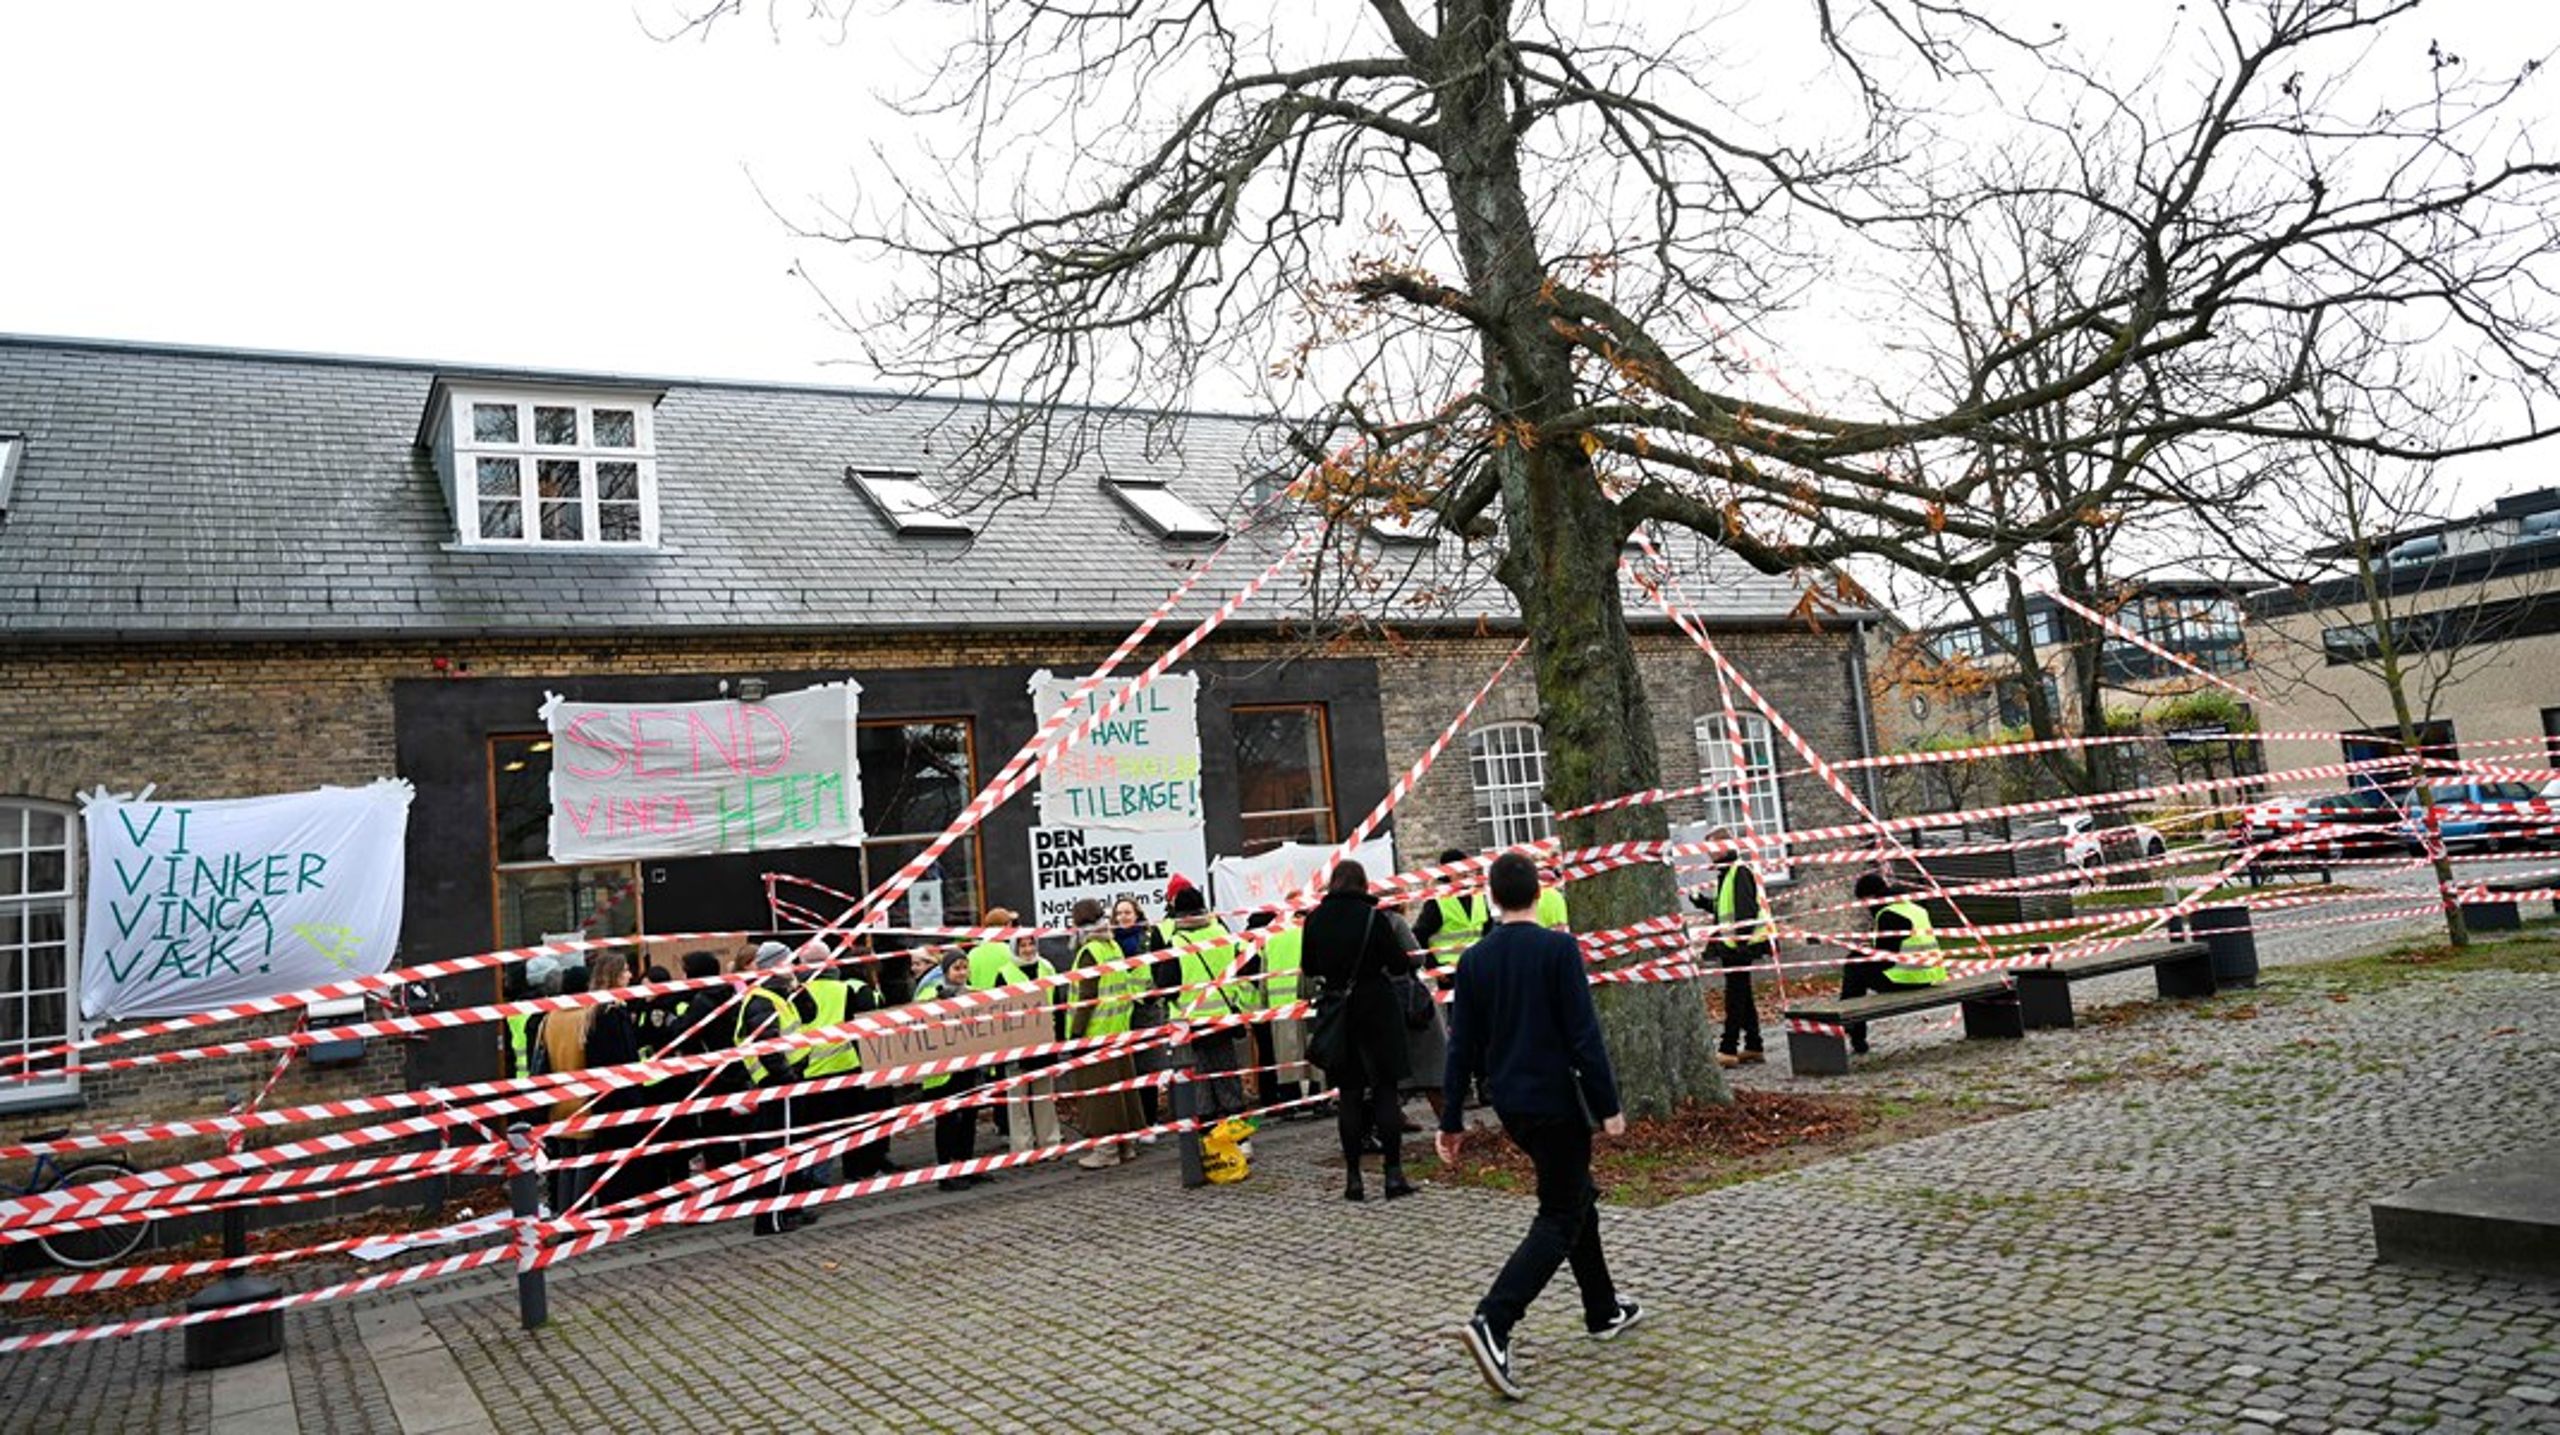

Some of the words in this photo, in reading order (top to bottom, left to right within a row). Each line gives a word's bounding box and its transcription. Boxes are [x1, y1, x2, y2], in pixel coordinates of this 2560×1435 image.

[566, 704, 792, 778] SEND
[1091, 720, 1149, 746] HAVE
[562, 795, 696, 838] VINCA
[717, 771, 846, 850] HJEM
[1066, 780, 1196, 818] TILBAGE!
[119, 806, 192, 855] VI
[1035, 829, 1085, 850] DEN
[114, 852, 327, 898] VINKER
[1038, 844, 1134, 870] DANSKE
[1039, 861, 1169, 890] FILMSKOLE
[110, 894, 273, 941] VINCA
[105, 926, 273, 984] VÆK!
